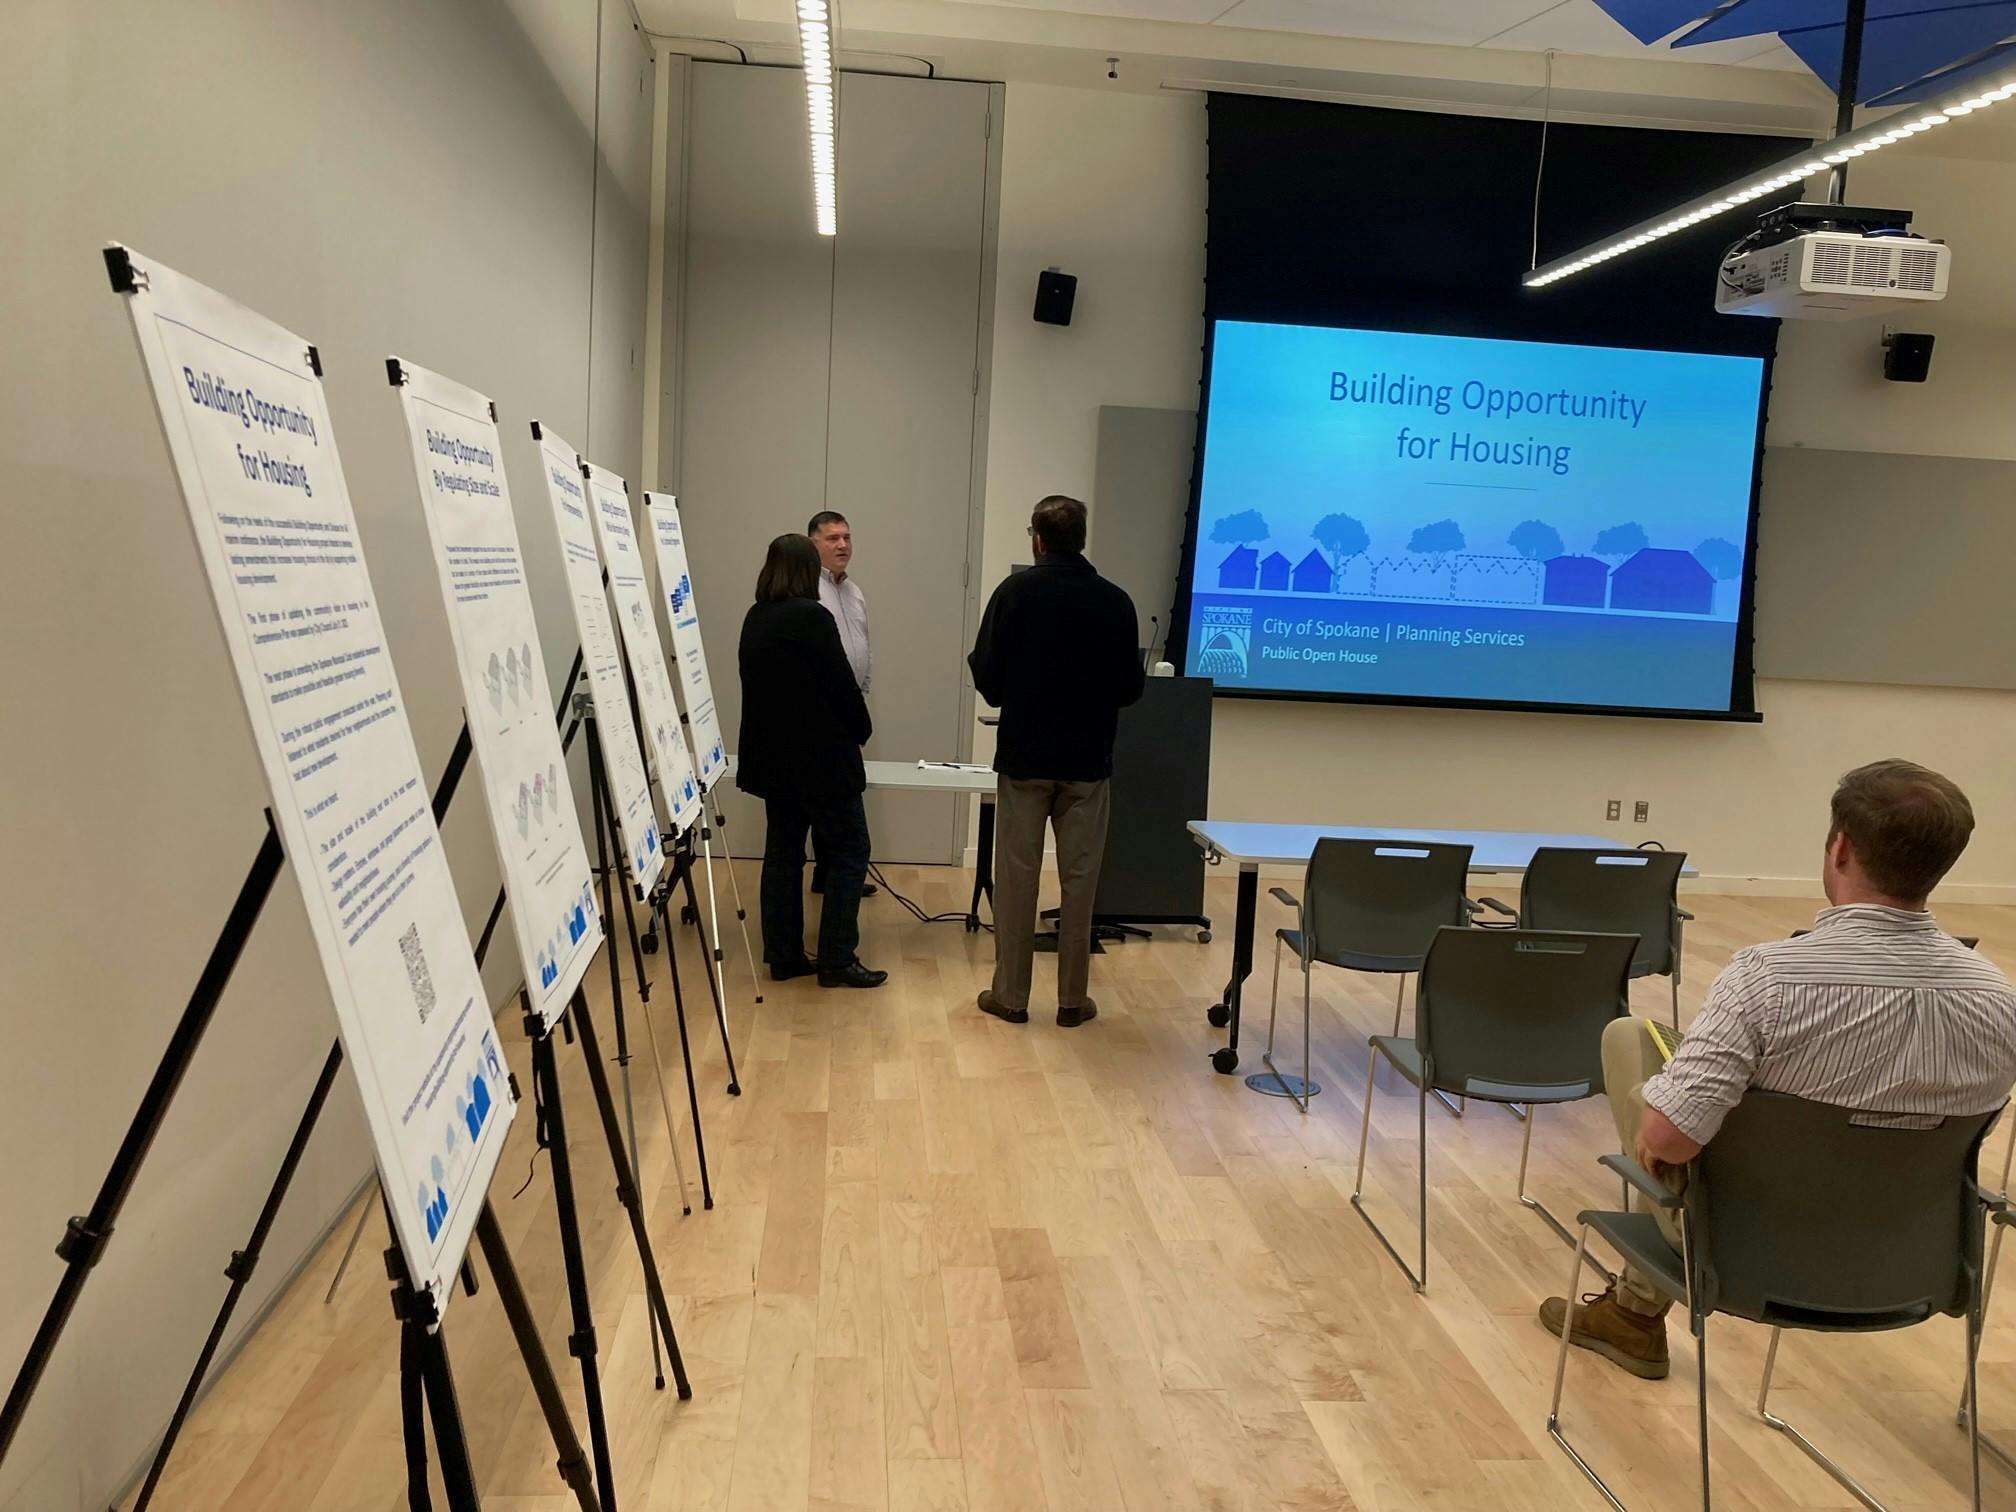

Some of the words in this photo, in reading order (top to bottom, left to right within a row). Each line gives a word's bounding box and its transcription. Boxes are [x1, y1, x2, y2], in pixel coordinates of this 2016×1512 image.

[183, 366, 250, 429] Building
[245, 389, 317, 446] Opportunity
[1329, 371, 1452, 415] Building
[1462, 380, 1647, 428] Opportunity
[236, 443, 261, 481] for
[257, 450, 312, 497] Housing
[1397, 427, 1440, 460] for
[1450, 432, 1571, 475] Housing
[1201, 613, 1252, 625] SPOKANE
[1263, 618, 1293, 638] City
[1296, 619, 1313, 636] of
[1315, 621, 1379, 641] Spokane
[1396, 624, 1461, 647] Planning
[1464, 629, 1525, 647] Services
[1262, 646, 1300, 661] Public
[1302, 648, 1336, 663] Open
[1339, 649, 1378, 664] House
